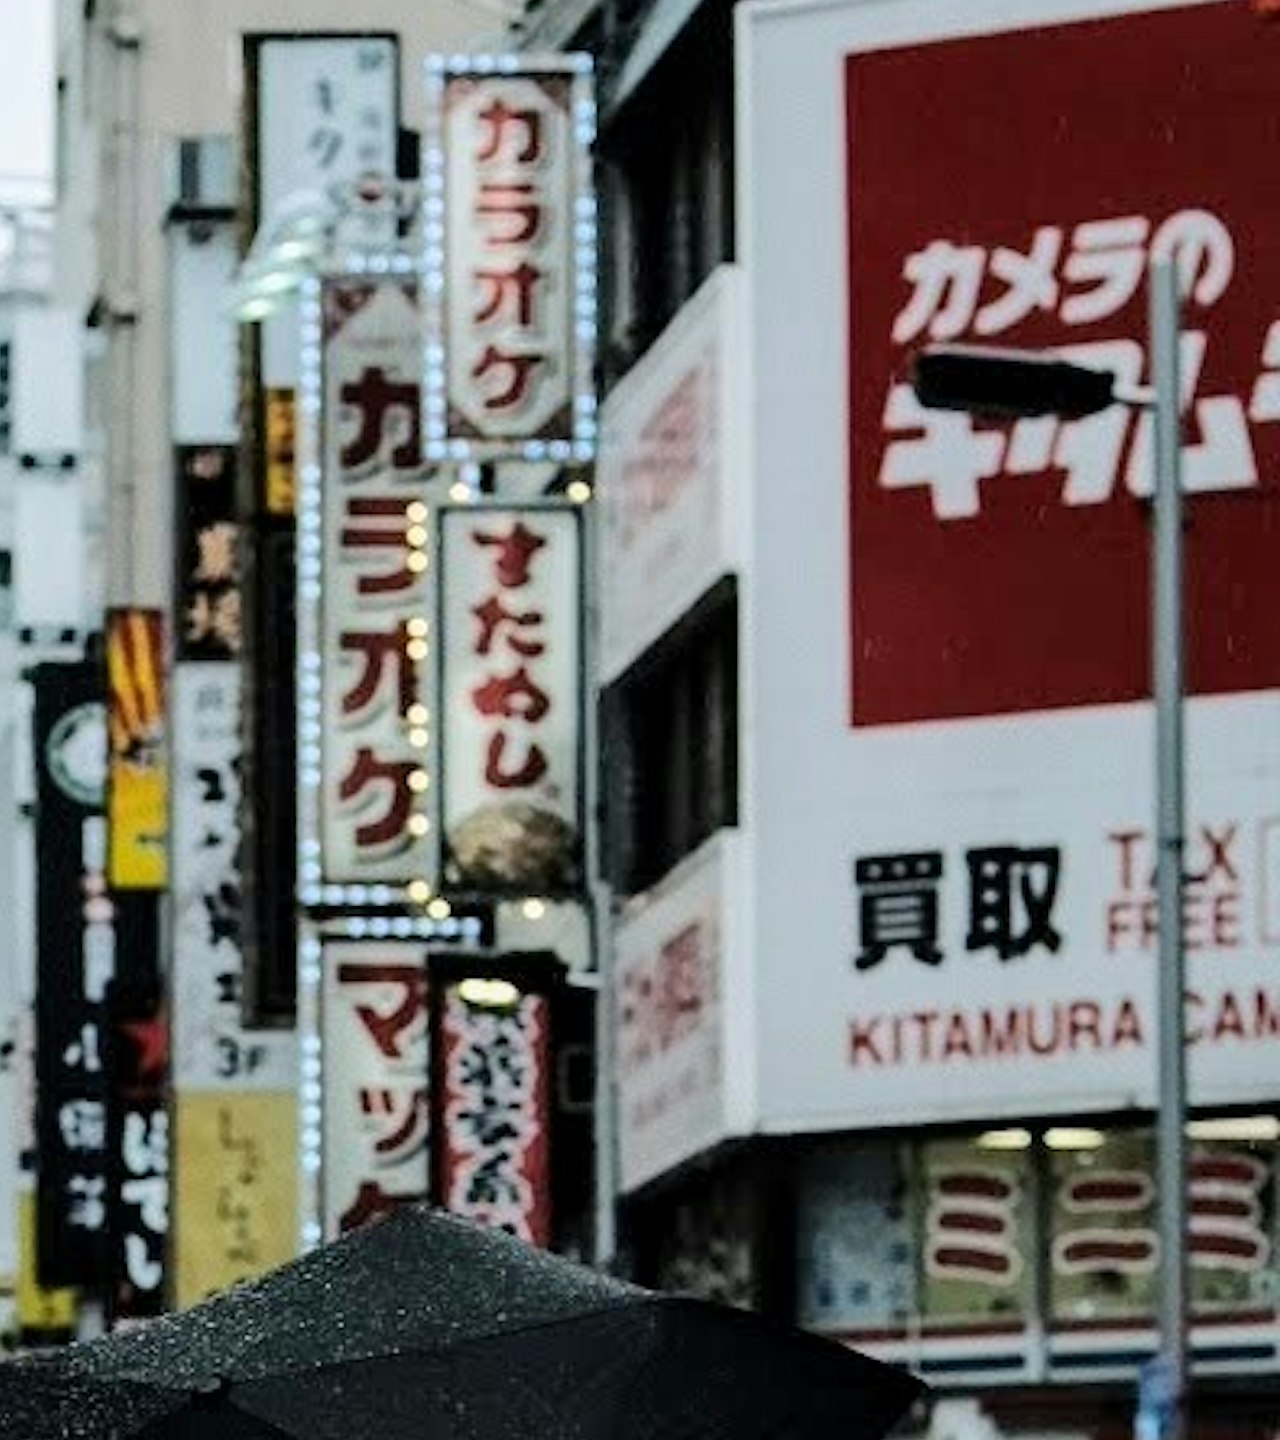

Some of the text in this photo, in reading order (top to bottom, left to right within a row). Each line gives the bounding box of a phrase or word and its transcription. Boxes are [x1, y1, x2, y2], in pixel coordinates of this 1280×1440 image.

[472, 96, 545, 410] カラオケ
[890, 210, 1235, 343] カメラの
[339, 366, 426, 850] カラオケ
[854, 844, 1063, 971] 買取
[848, 998, 1144, 1066] KITAMURA
